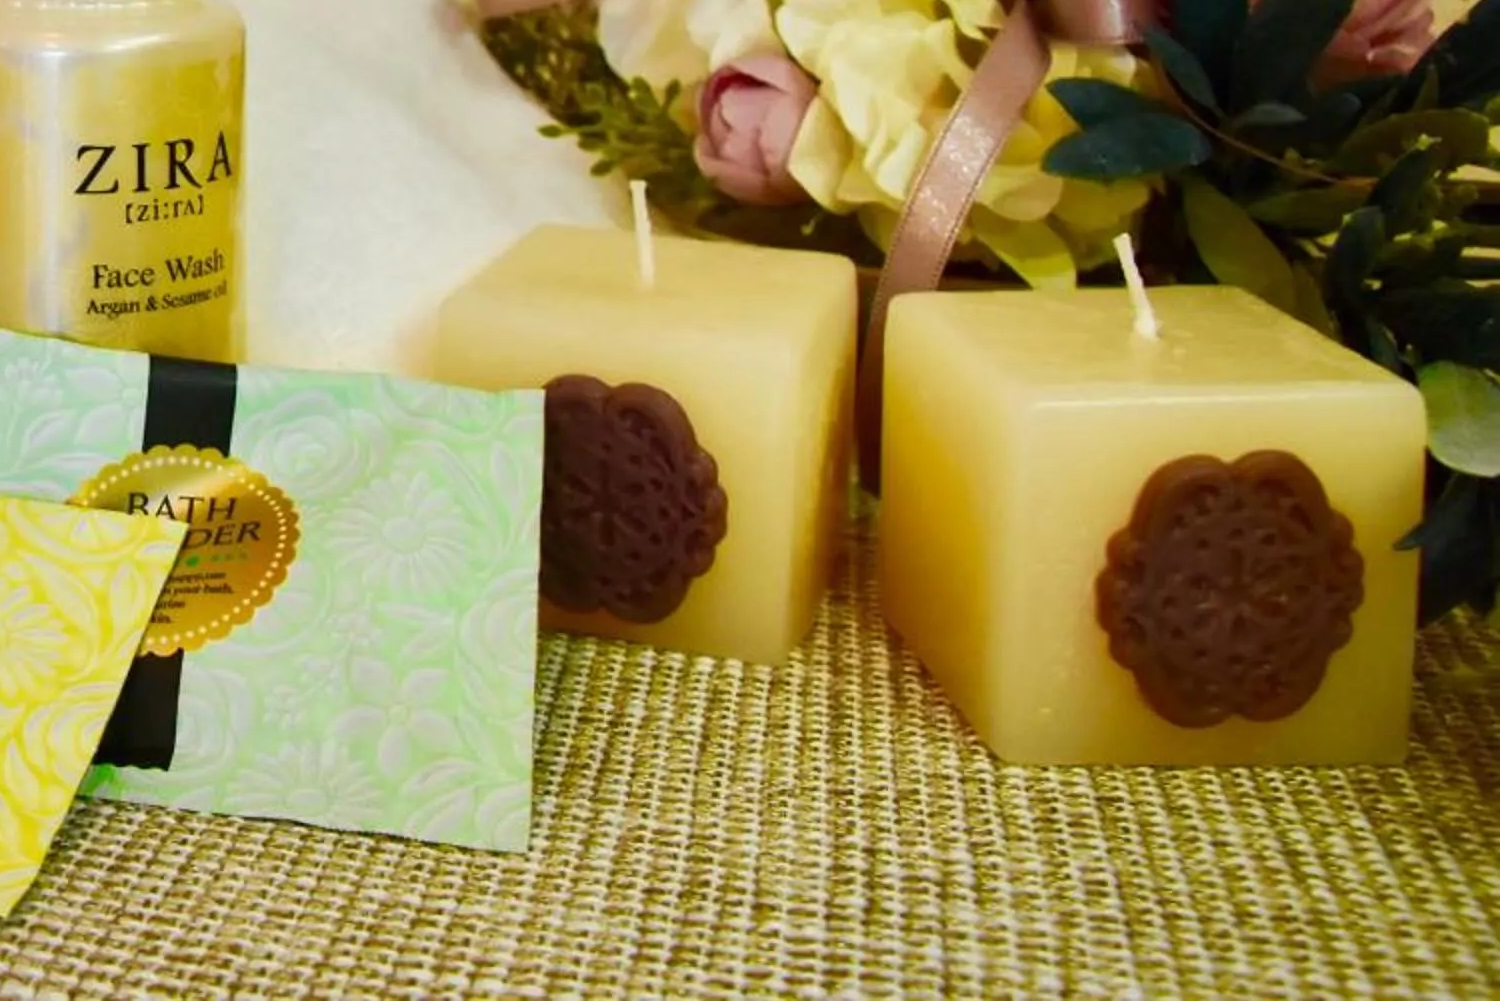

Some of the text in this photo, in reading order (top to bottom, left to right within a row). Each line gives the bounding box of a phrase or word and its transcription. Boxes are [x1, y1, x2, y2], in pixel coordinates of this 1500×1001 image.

[74, 130, 233, 195] ZIRA
[91, 247, 225, 290] Face Wash
[86, 298, 141, 319] Argan
[145, 294, 158, 312] &
[161, 287, 213, 310] Sesame
[181, 520, 262, 550] DER
